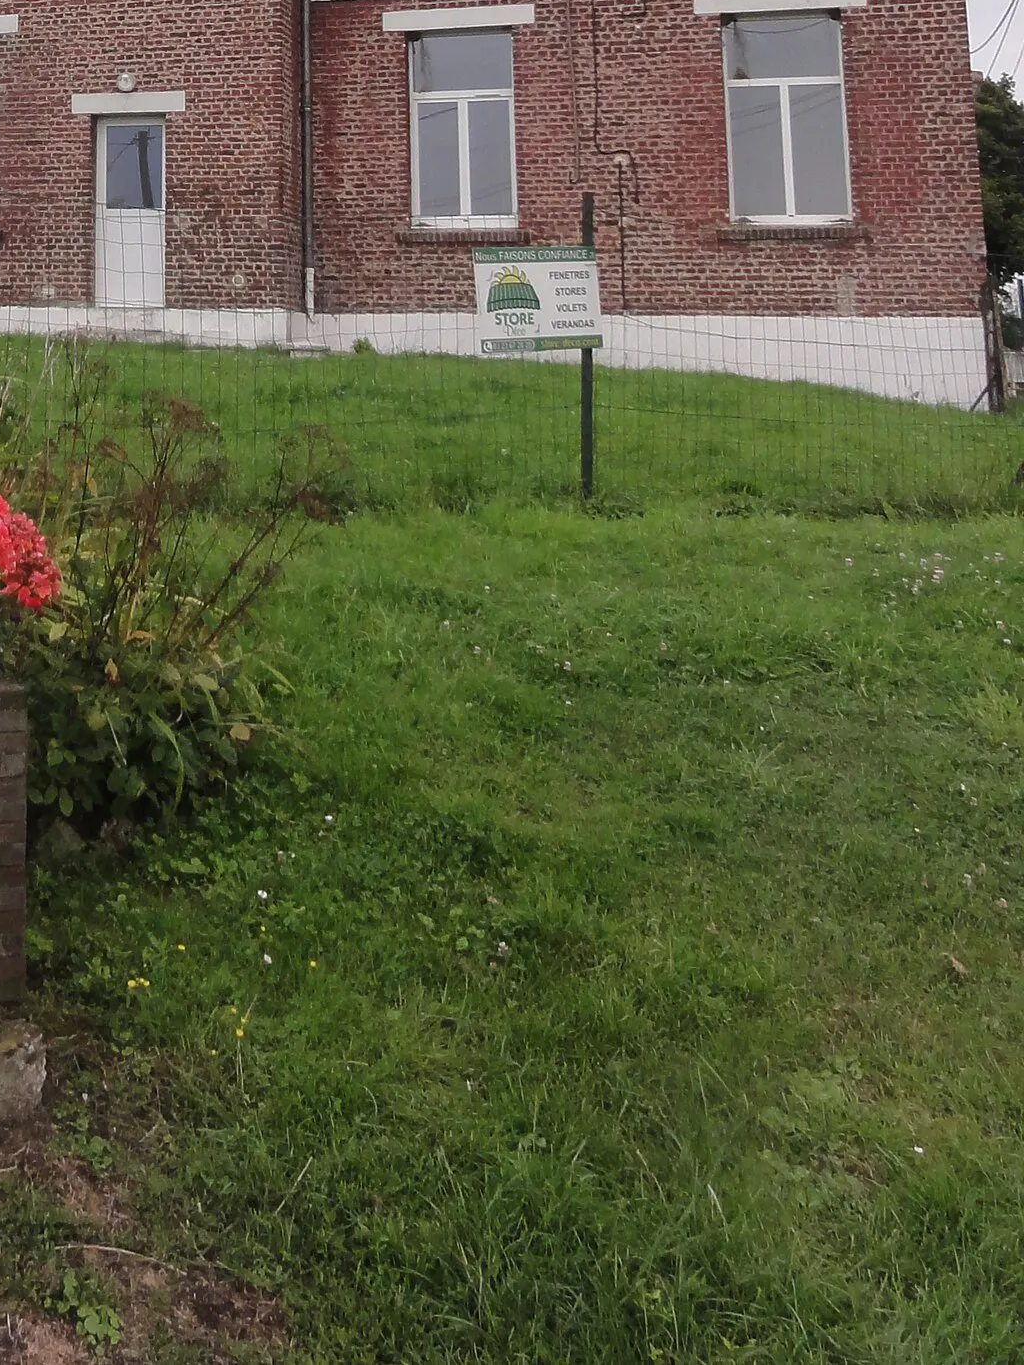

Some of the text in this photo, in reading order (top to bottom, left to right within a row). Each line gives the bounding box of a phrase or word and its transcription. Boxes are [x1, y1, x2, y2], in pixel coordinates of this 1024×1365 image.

[475, 251, 498, 261] Nous
[499, 250, 537, 261] FAISONS
[538, 249, 587, 260] CONFIANCE
[555, 287, 587, 296] STORES
[556, 303, 588, 312] VOLETS
[494, 312, 535, 325] STORE
[551, 319, 595, 329] VERANDAS
